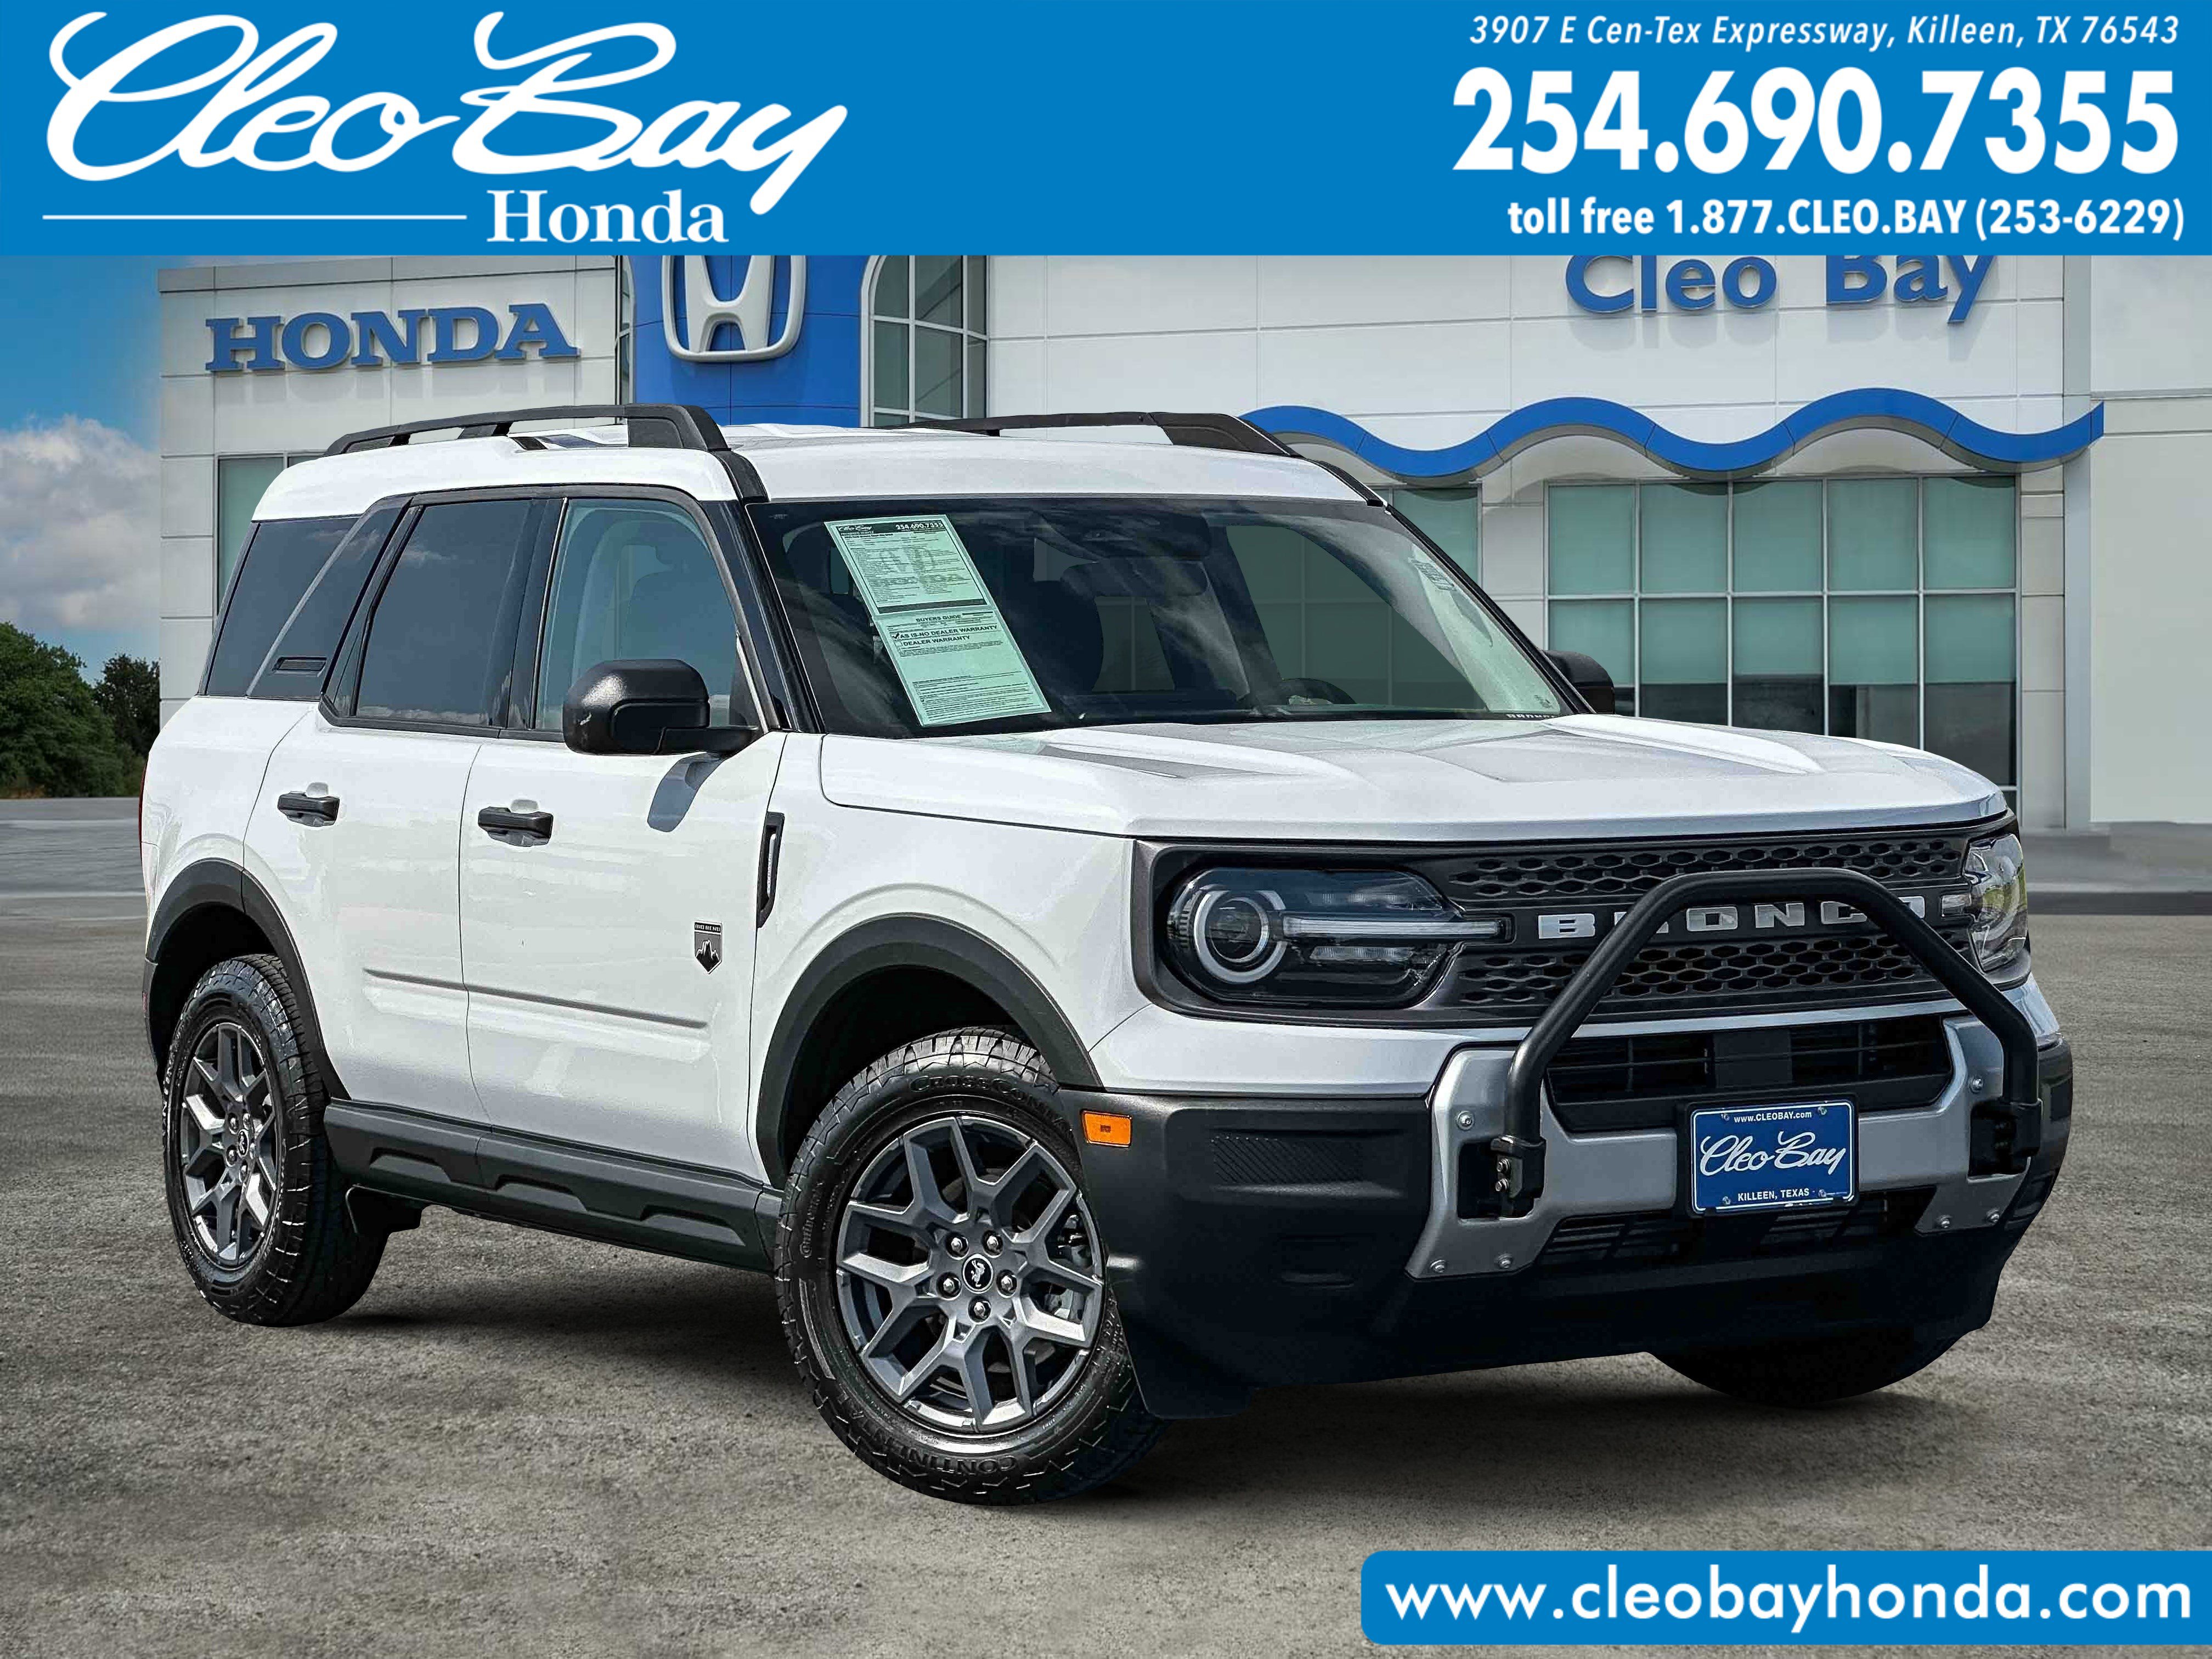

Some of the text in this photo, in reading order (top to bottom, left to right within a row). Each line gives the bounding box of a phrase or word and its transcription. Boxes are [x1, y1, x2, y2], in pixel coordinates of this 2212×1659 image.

[1565, 255, 1998, 324] Cleo Bay
[205, 303, 580, 372] HONDA
[932, 635, 970, 643] WARRANTY
[1734, 1111, 1812, 1122] www.CLEOBAY.com
[1700, 1130, 1846, 1176] Cleo Bay
[1737, 1187, 1810, 1201] KILLEEN, TEXAS
